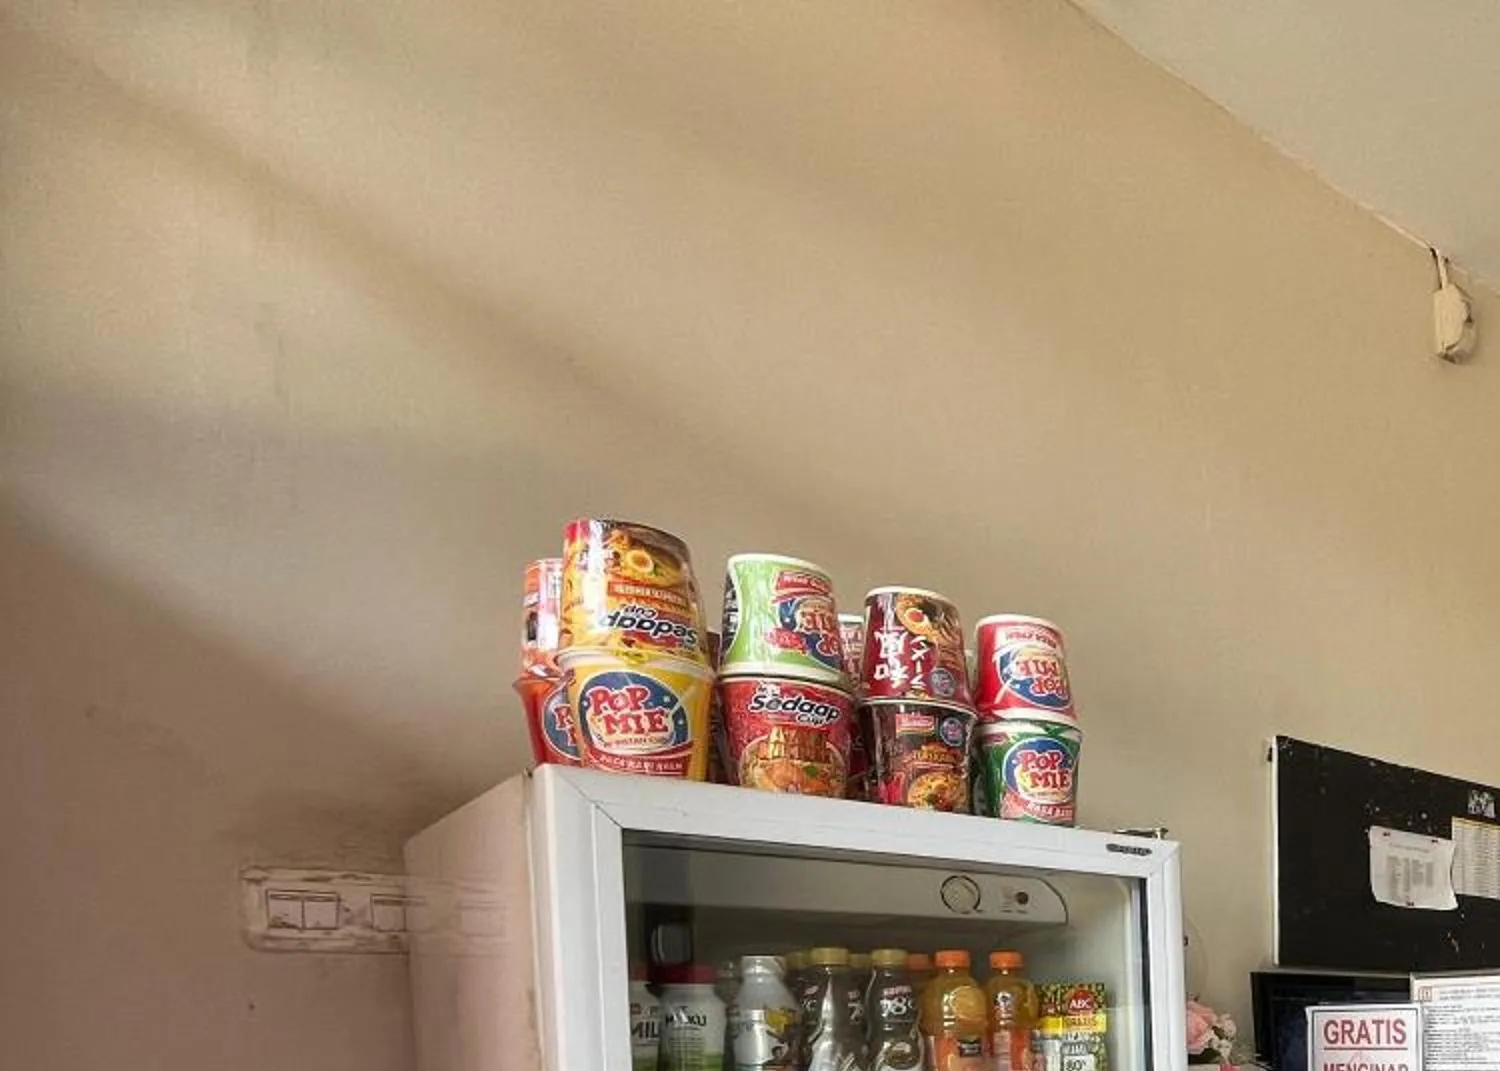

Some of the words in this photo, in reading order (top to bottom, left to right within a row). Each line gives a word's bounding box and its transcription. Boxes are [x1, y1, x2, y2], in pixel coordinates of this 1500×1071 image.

[600, 609, 698, 646] Sedaap
[586, 684, 651, 716] POP
[748, 693, 841, 721] Sedaap
[602, 707, 671, 736] MIE
[1016, 749, 1064, 772] POP
[1030, 768, 1073, 789] MIE
[1323, 1018, 1407, 1045] GRATIS
